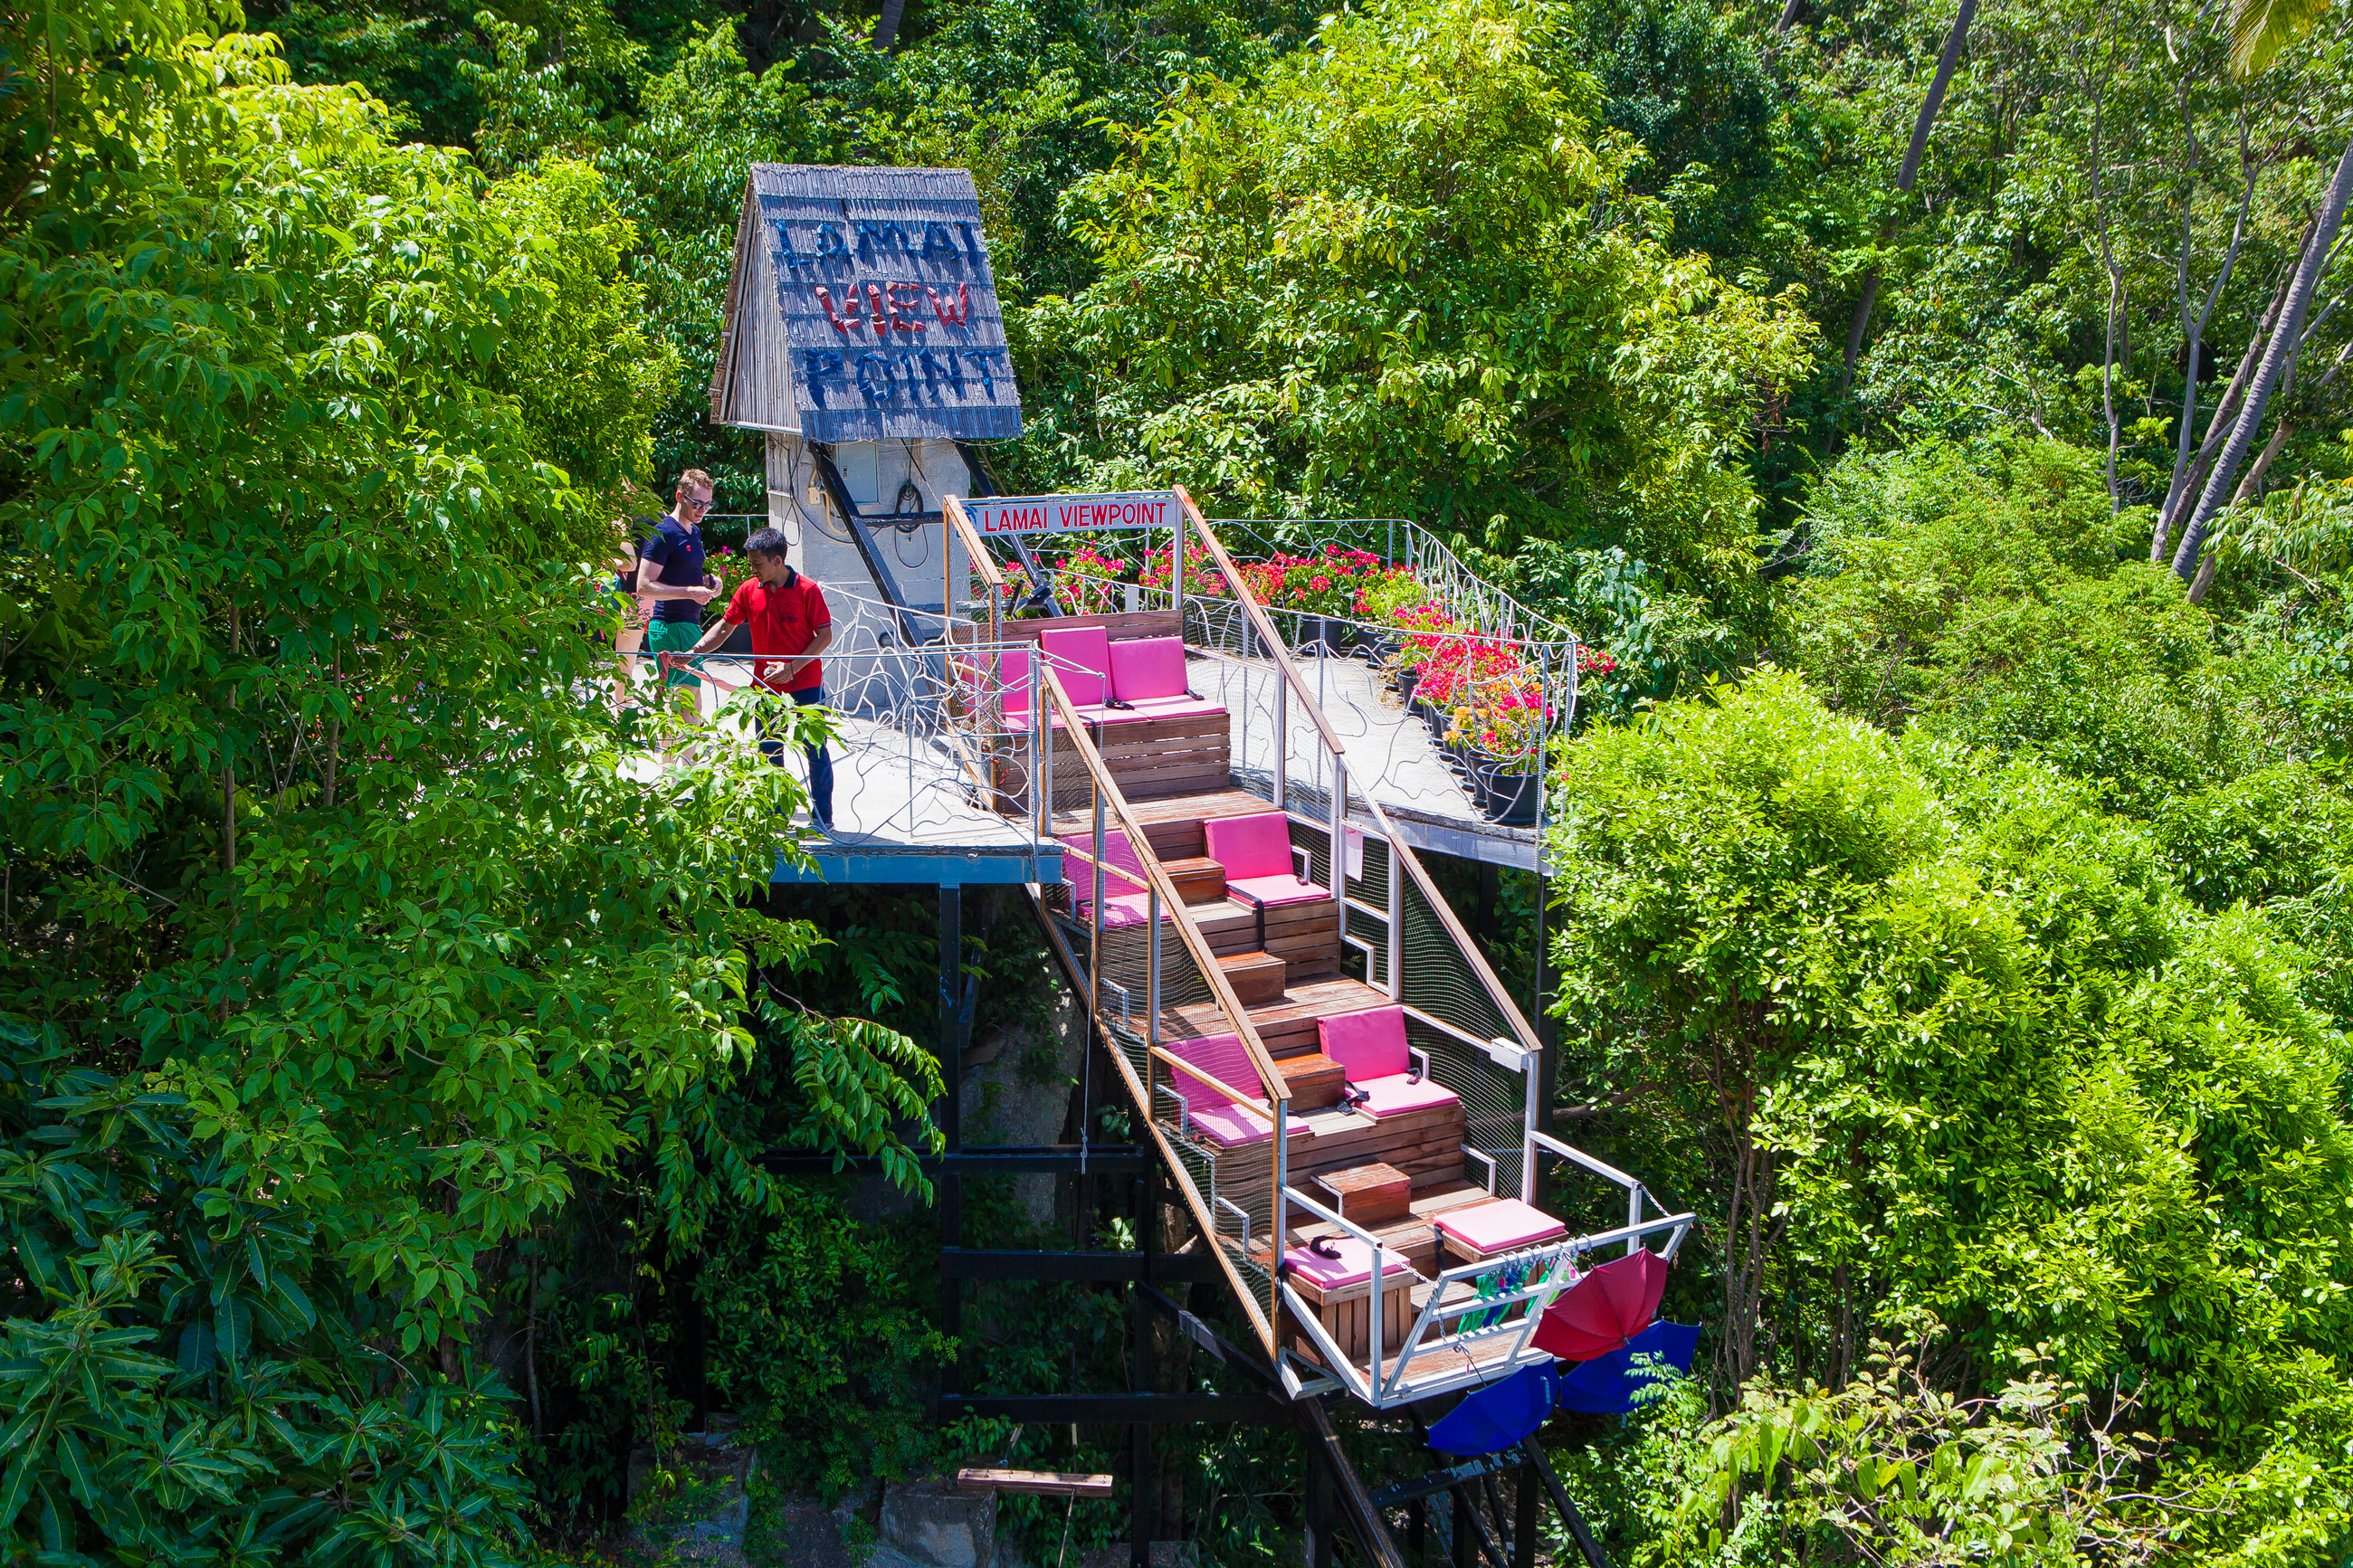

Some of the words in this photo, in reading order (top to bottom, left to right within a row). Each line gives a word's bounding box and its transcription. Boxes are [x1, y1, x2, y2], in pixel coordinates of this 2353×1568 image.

[776, 219, 978, 270] LAMAI
[814, 280, 969, 336] VIEW
[804, 347, 1003, 408] POINT
[984, 507, 1048, 533] LAMAI
[1058, 502, 1167, 528] VIEWPOINT
